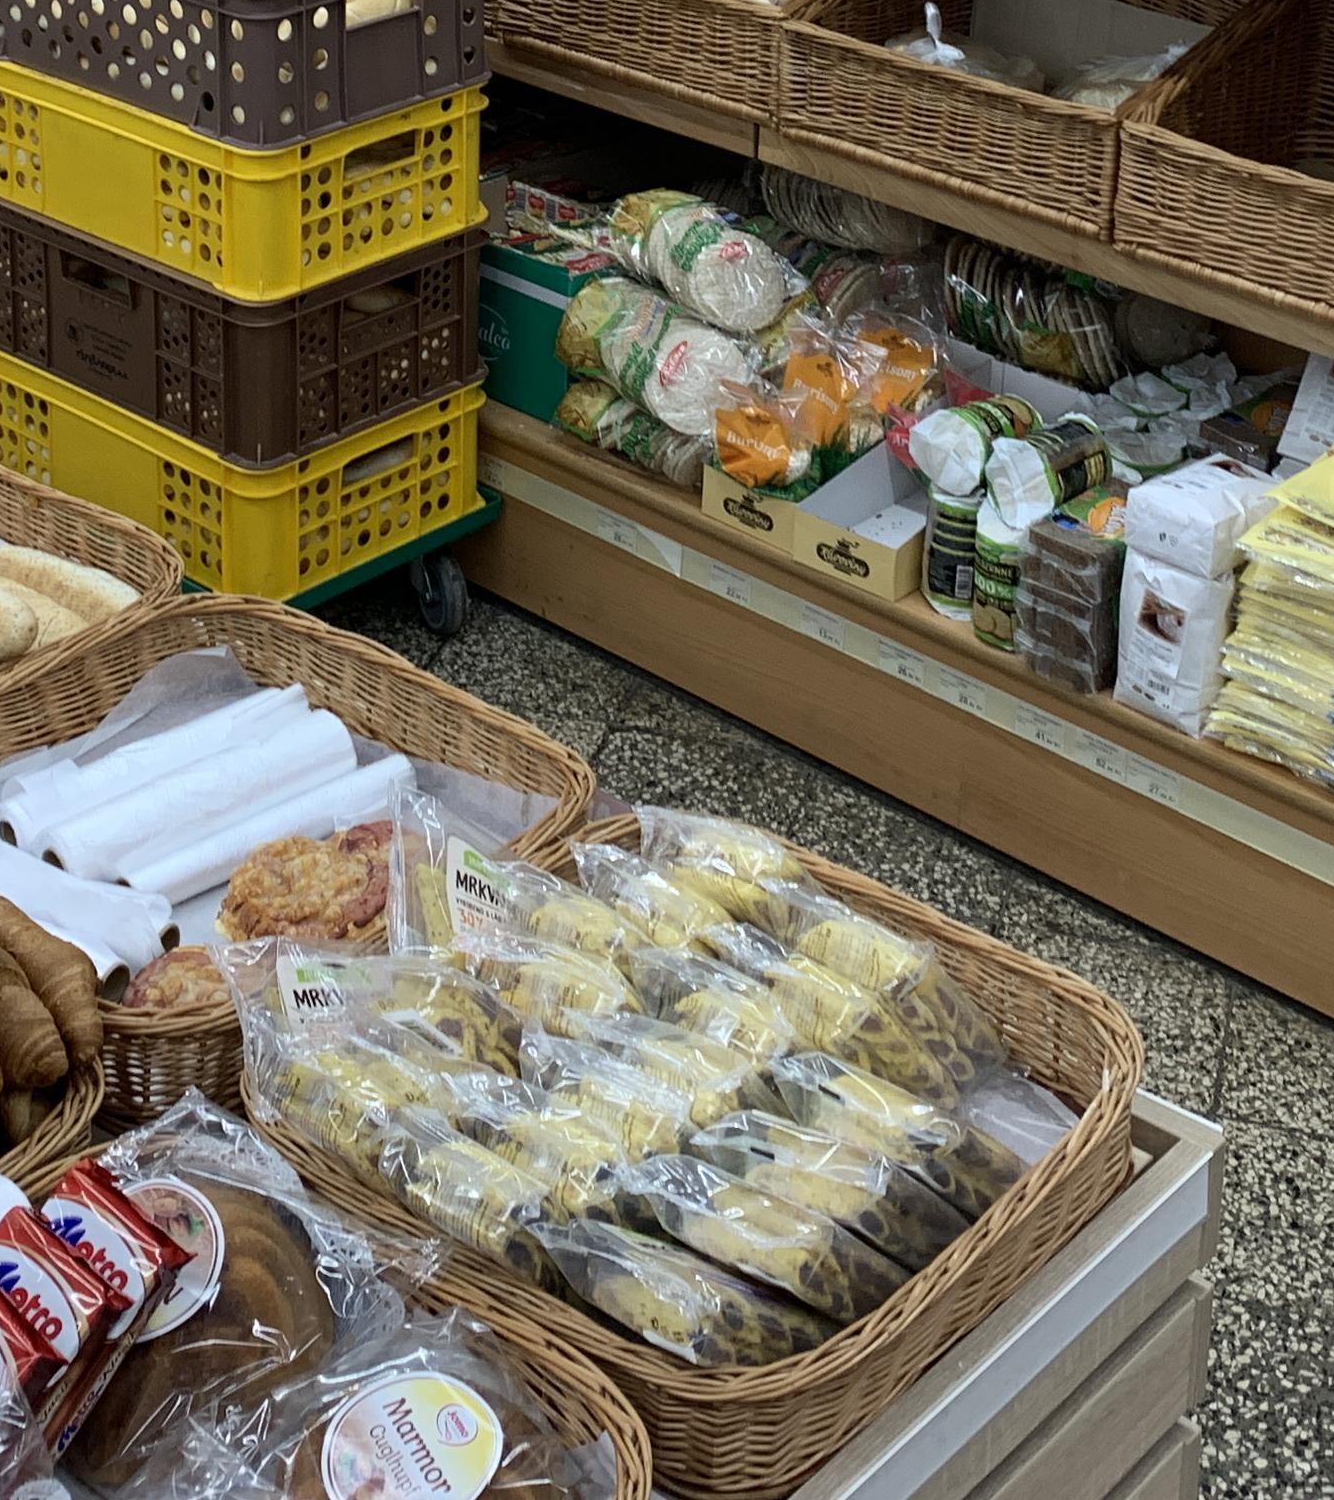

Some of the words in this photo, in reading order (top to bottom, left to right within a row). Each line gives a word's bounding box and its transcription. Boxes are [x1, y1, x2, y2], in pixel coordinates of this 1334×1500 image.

[480, 320, 511, 352] alco
[456, 870, 509, 907] MRKV
[52, 1215, 129, 1296] Metro
[382, 1397, 452, 1494] Marmor
